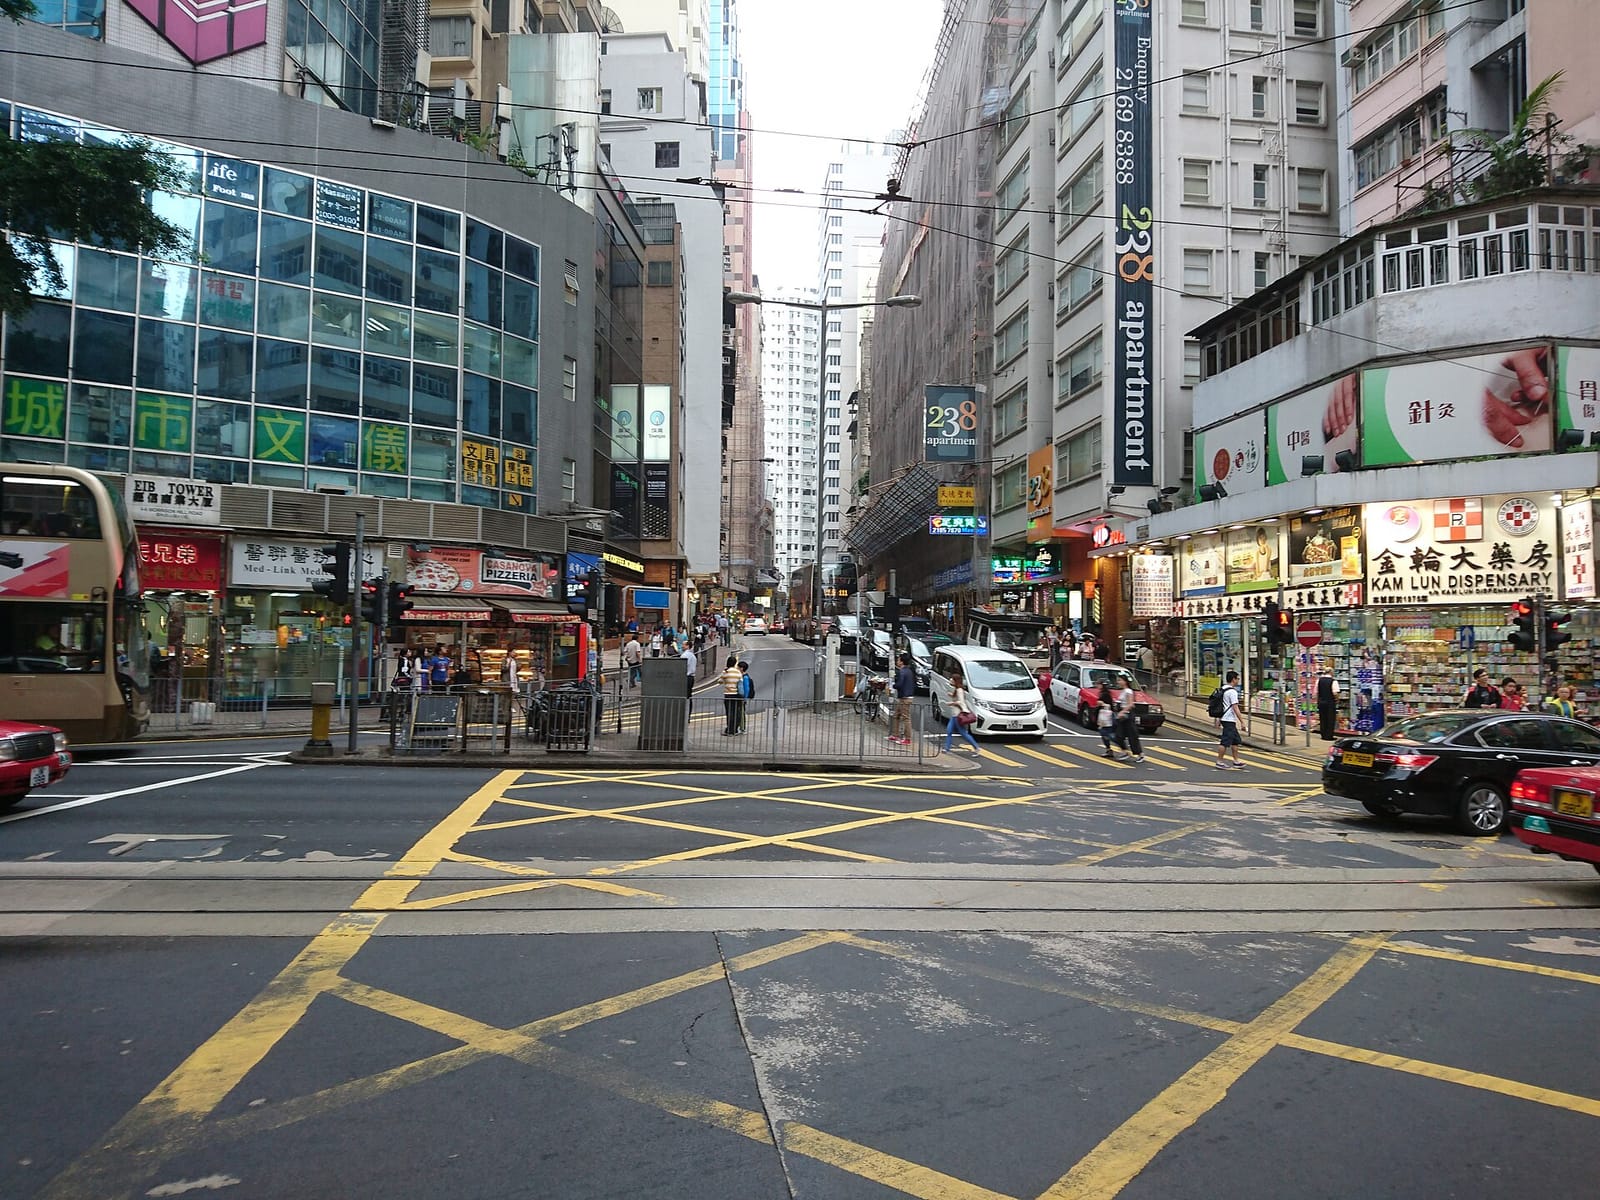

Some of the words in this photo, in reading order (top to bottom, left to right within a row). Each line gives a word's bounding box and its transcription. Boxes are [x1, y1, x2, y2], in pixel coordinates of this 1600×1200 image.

[1135, 36, 1151, 104] Enquiry
[1116, 67, 1134, 122] 2169
[1116, 130, 1134, 184] 8388
[213, 184, 236, 197] Foot
[1116, 203, 1154, 283] 238
[1118, 300, 1151, 471] apartment
[6, 380, 66, 438] 城
[137, 397, 191, 448] 市
[256, 410, 303, 463] 文
[364, 424, 406, 474] 儀
[927, 400, 977, 438] 238
[1408, 399, 1455, 425] 針灸
[927, 436, 977, 447] apartmen
[134, 480, 156, 493] EIB
[168, 483, 214, 498] TOWER
[486, 559, 538, 573] CASANOVA
[1371, 540, 1553, 576] 金輪大藥房
[486, 569, 538, 582] PIZZERIA
[1371, 576, 1404, 592] KAM
[1410, 575, 1441, 590] LUN
[1448, 571, 1553, 589] DISPENSARY
[1475, 586, 1524, 595] DISPENSARY
